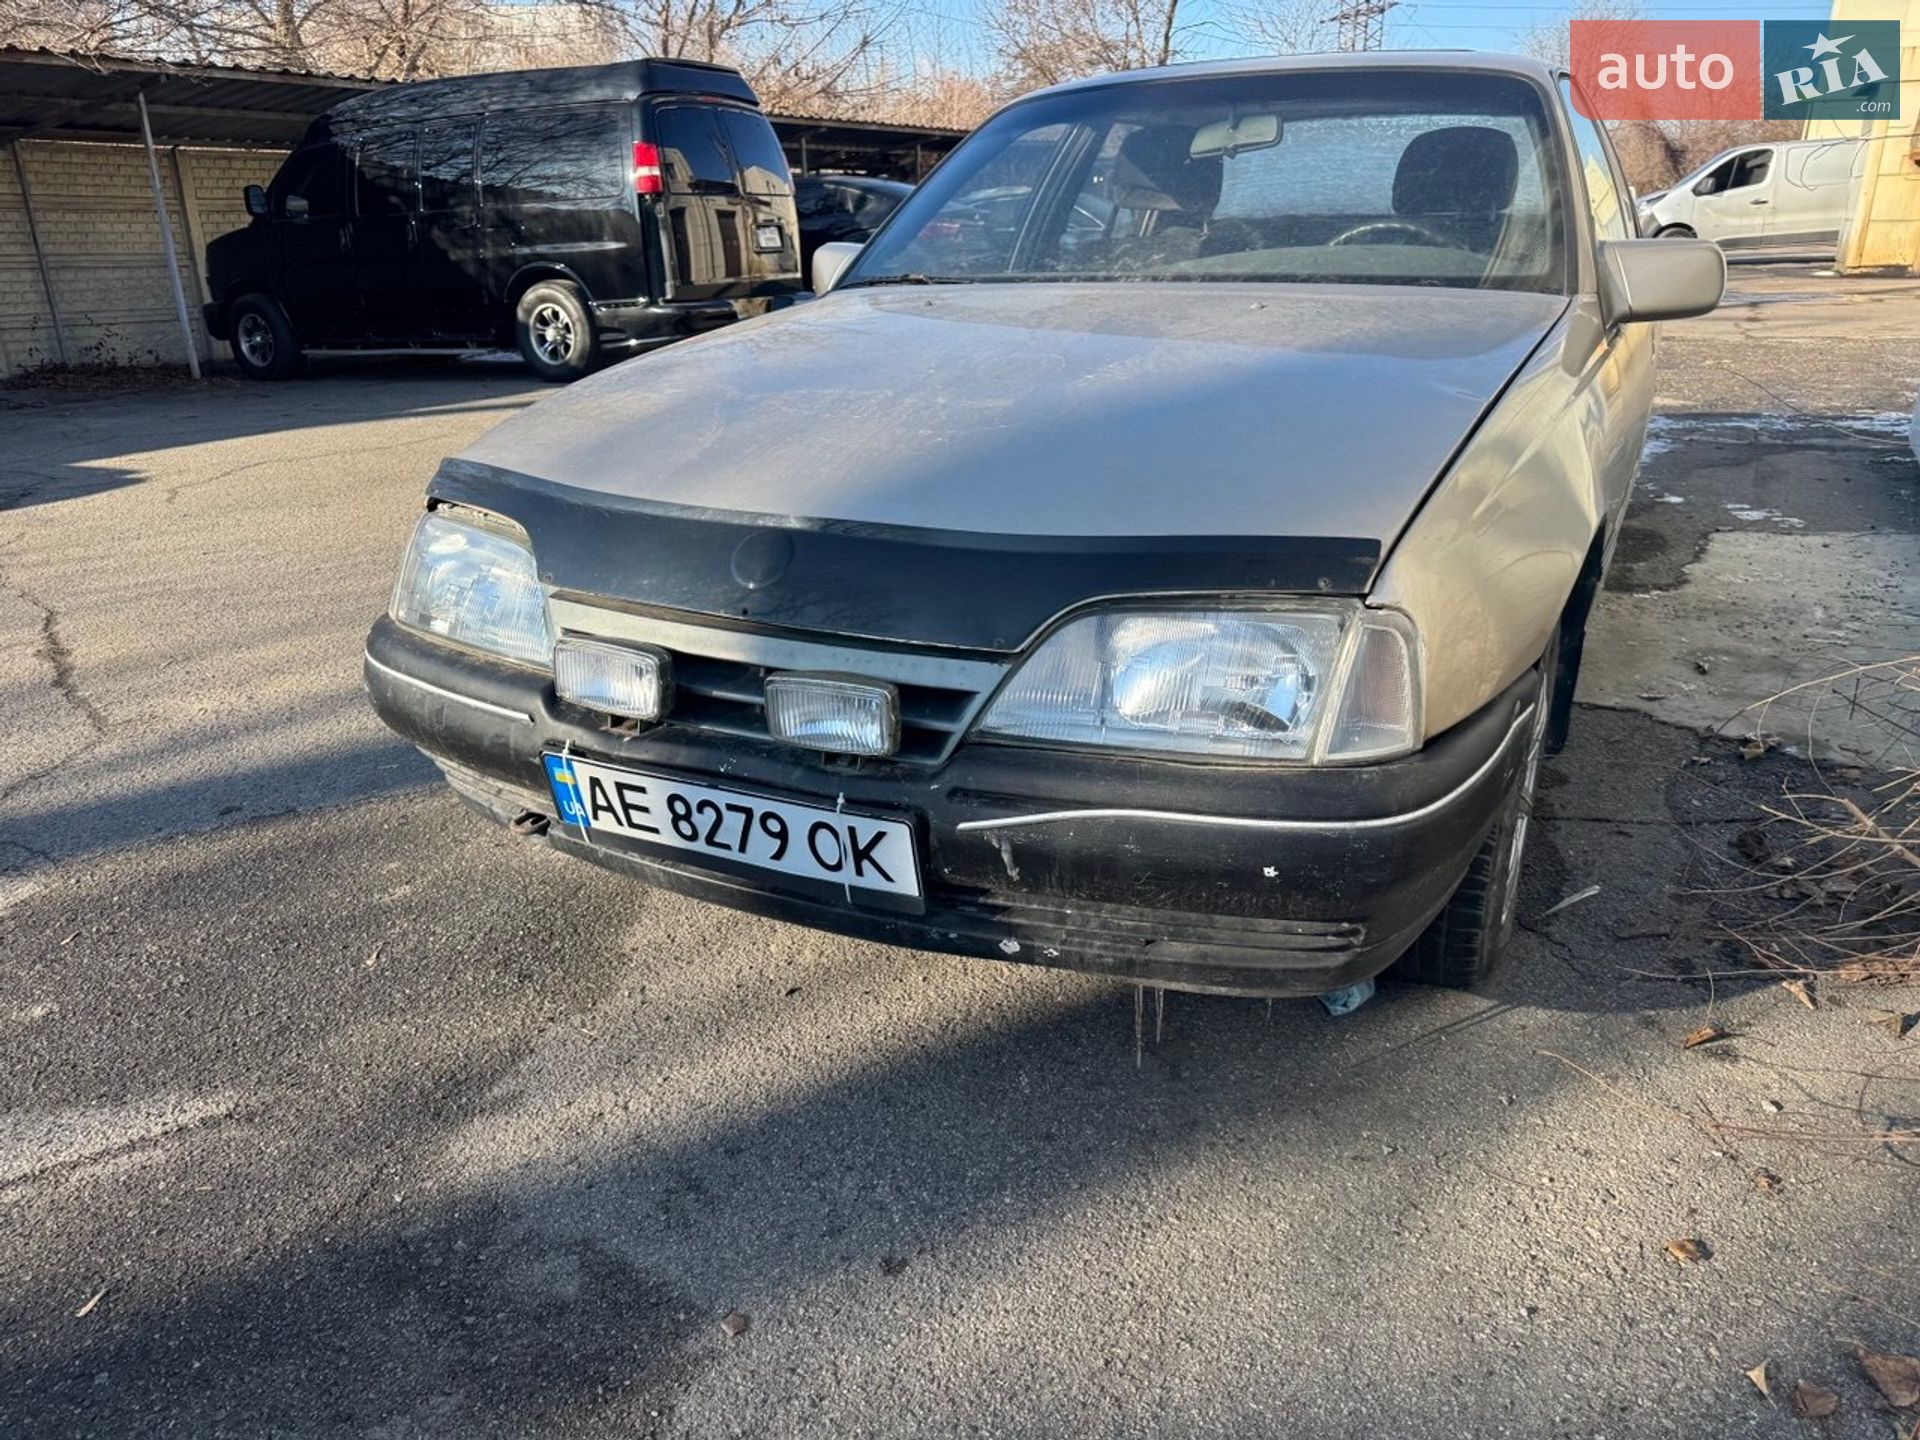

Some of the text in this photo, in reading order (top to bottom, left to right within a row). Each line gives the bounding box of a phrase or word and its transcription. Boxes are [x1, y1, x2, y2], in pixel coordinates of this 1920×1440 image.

[589, 776, 895, 883] AE 8279 OK
